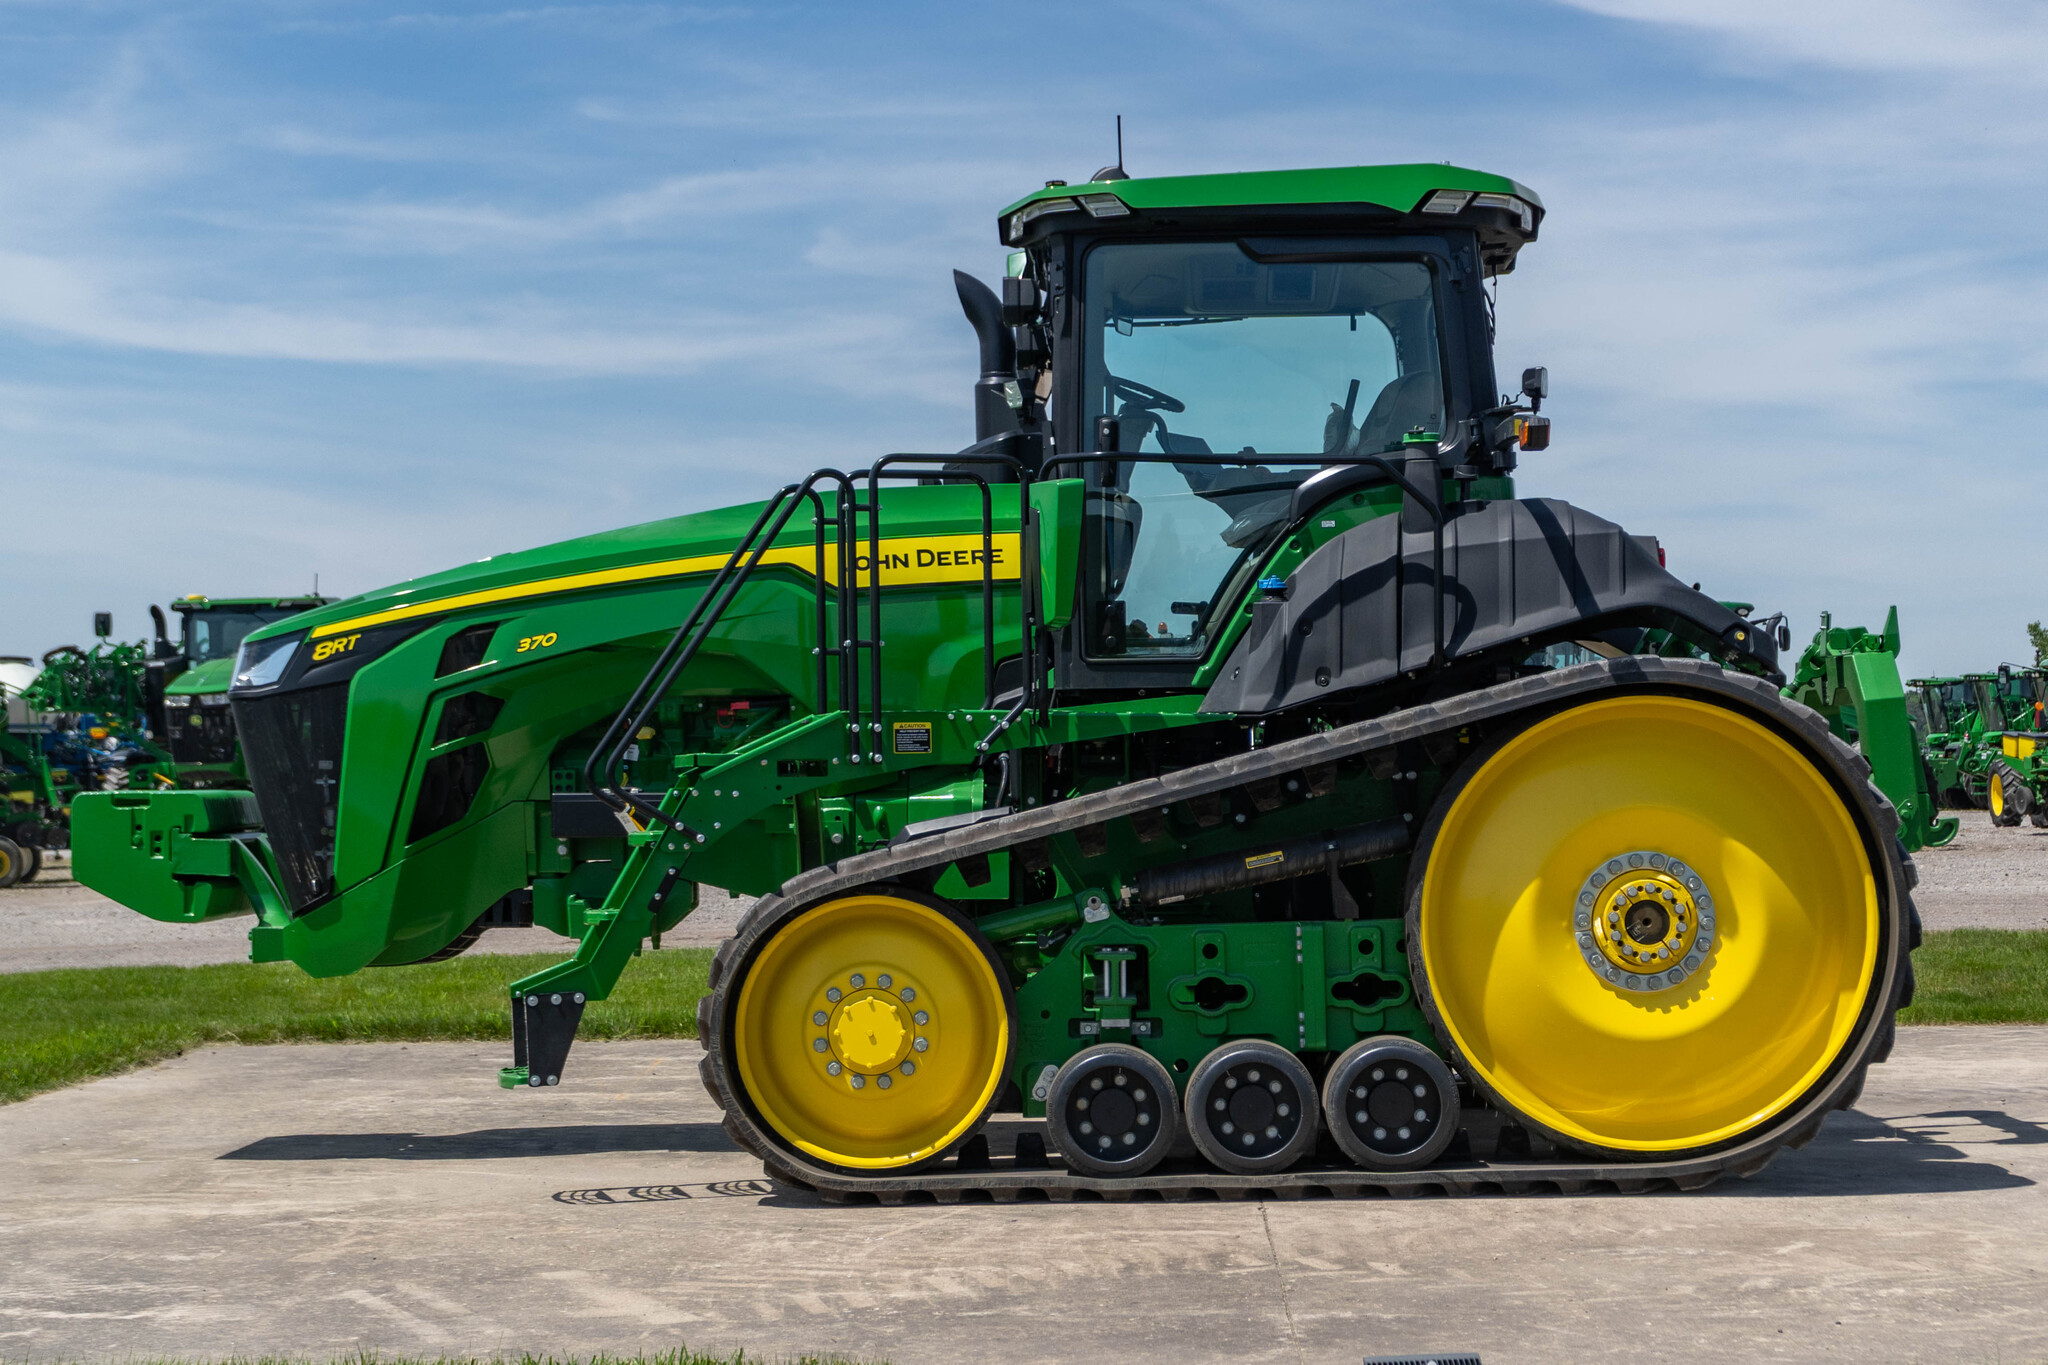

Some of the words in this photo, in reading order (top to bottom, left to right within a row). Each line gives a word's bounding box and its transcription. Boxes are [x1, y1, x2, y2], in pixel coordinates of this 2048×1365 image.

[848, 553, 909, 572] OHN
[916, 549, 1004, 567] DEERE
[312, 633, 362, 661] 8RT
[516, 632, 558, 653] 370
